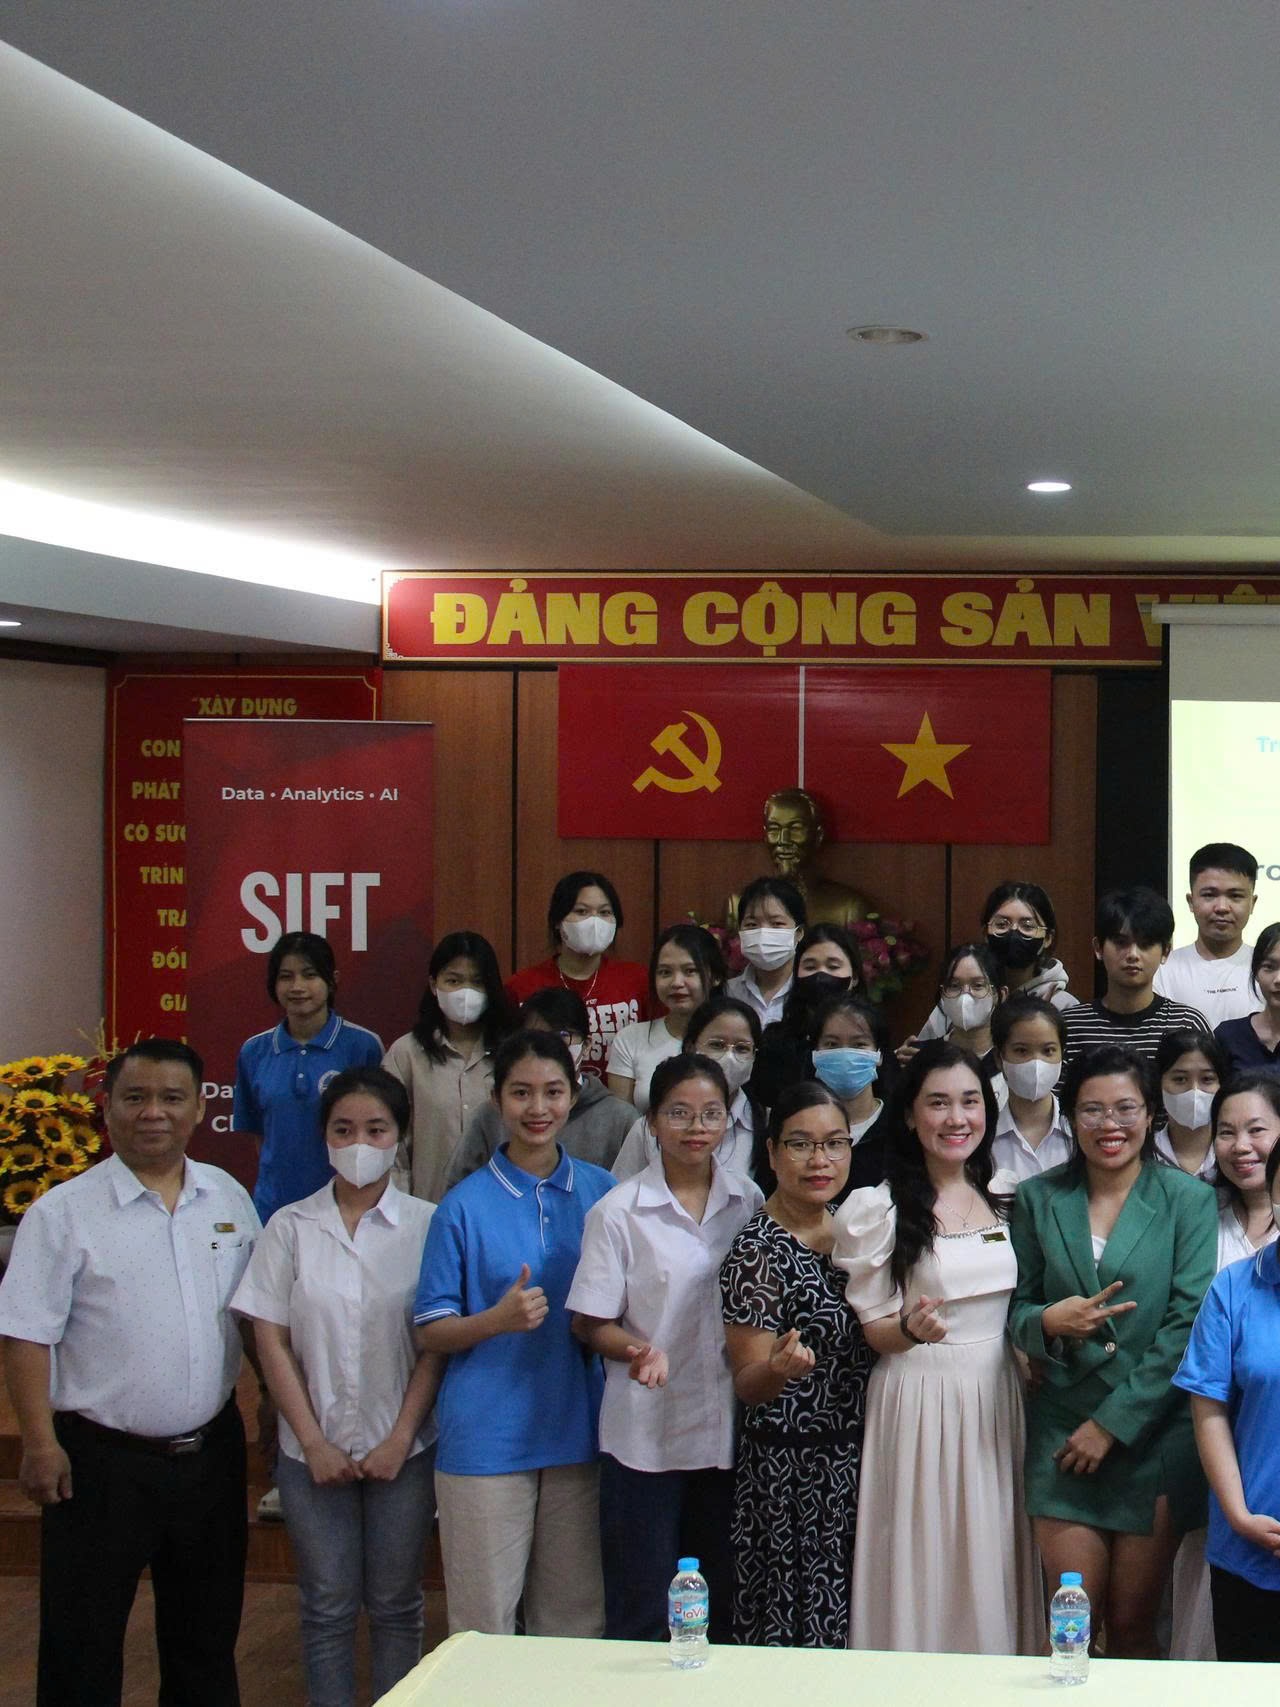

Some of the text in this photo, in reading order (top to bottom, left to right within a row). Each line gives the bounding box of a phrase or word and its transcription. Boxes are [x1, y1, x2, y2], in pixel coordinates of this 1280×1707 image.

[430, 578, 659, 647] ĐẢNG
[682, 581, 917, 657] CỘNG
[940, 578, 1111, 647] SẢN
[221, 786, 399, 804] Data Analytics AI
[239, 871, 381, 954] SIFT
